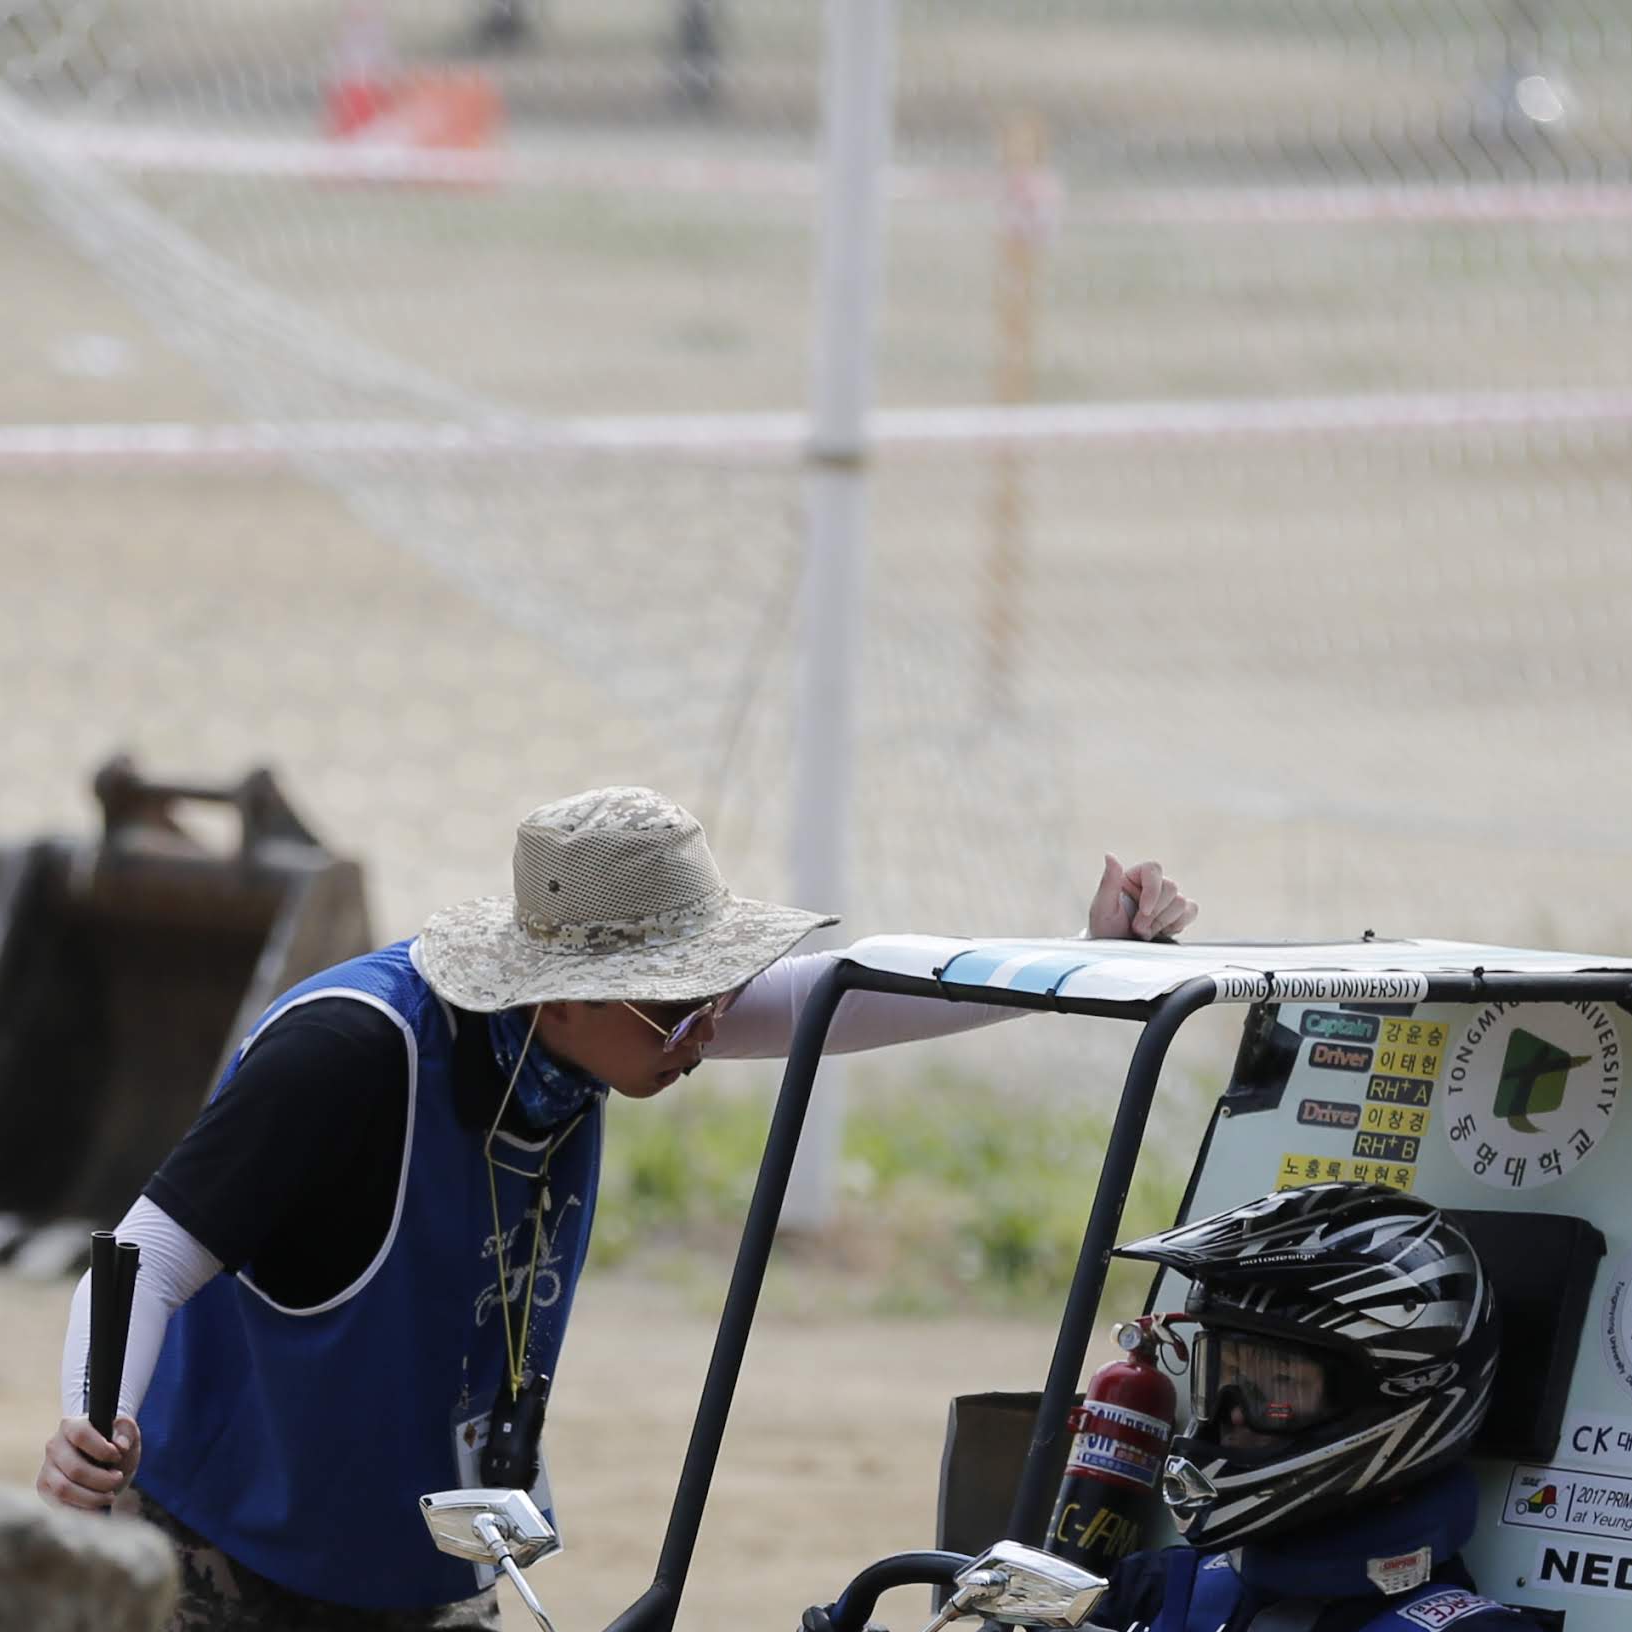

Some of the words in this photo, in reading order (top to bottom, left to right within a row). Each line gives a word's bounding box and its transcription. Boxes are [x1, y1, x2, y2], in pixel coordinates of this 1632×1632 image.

[1224, 978, 1326, 998] TONGMYONG
[1330, 978, 1421, 998] UNIVERSITY
[1305, 1013, 1373, 1037] Captain
[1314, 1044, 1367, 1067] Driver
[1413, 1085, 1427, 1103] A
[1302, 1101, 1357, 1124] Driver
[1401, 1141, 1415, 1159] B
[1572, 1425, 1614, 1455] CK
[1576, 1485, 1606, 1507] 2017
[1572, 1508, 1591, 1524] at
